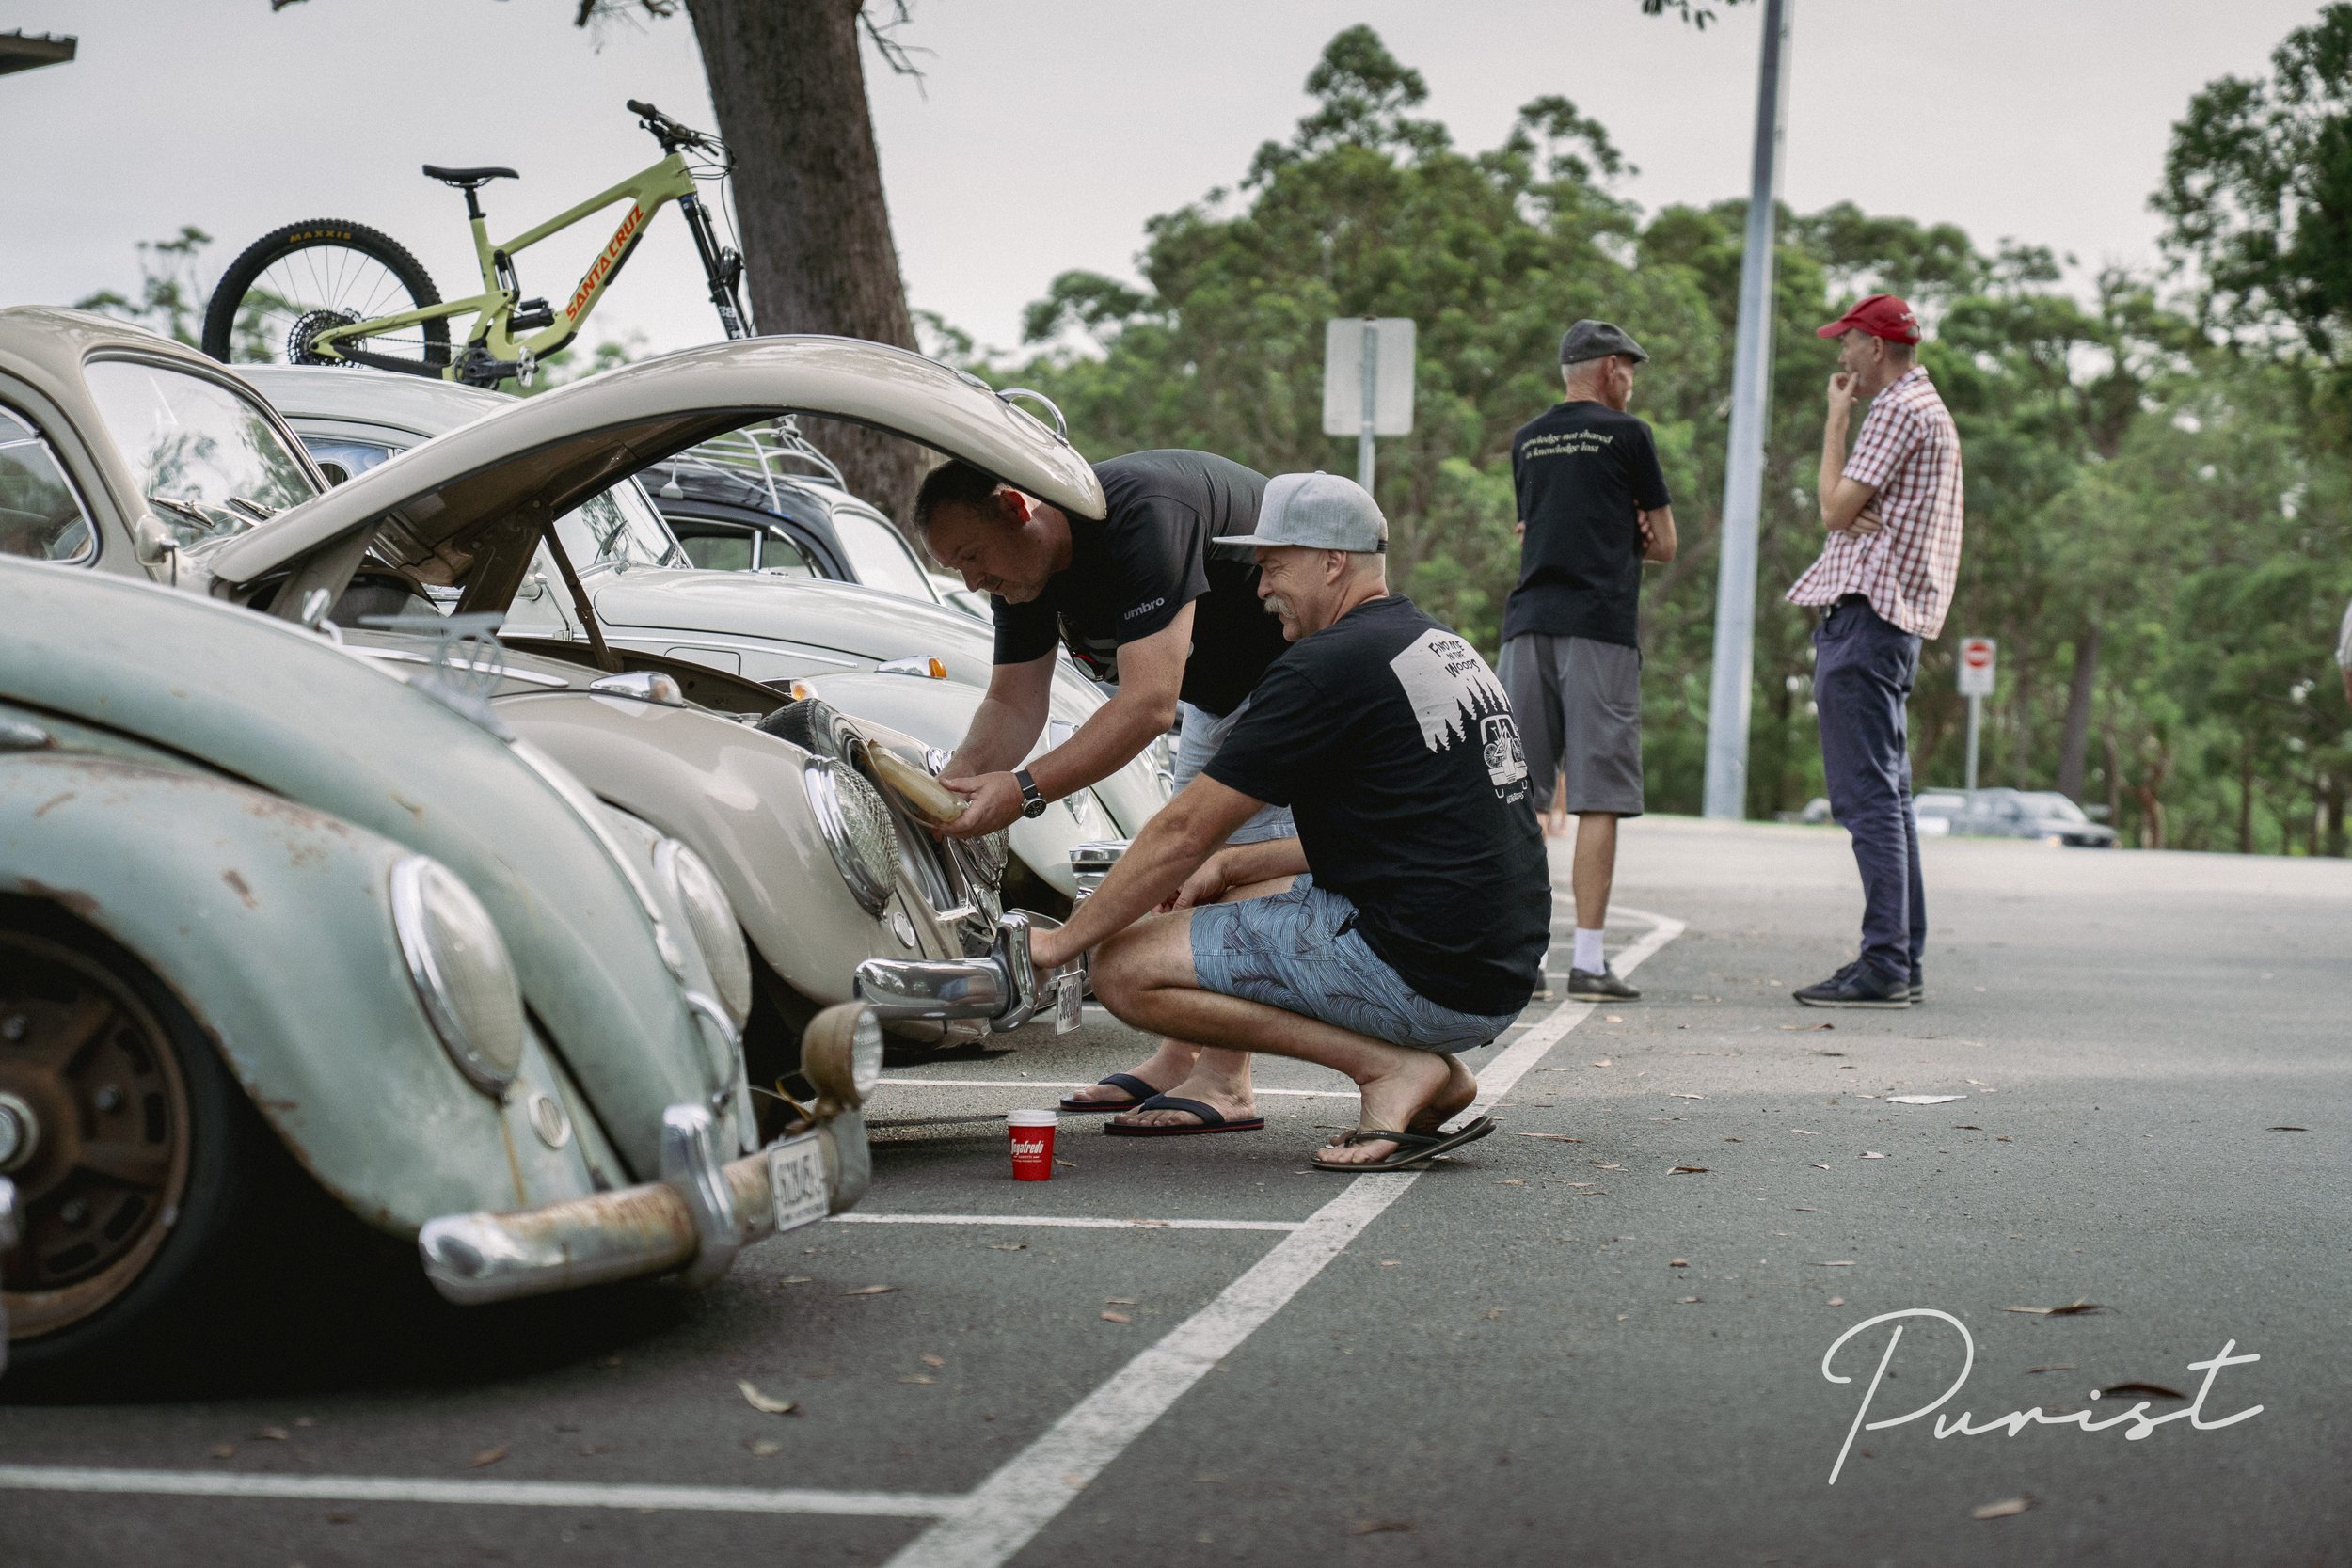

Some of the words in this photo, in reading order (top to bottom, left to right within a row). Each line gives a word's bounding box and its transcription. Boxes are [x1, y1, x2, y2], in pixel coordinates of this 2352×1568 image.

[290, 230, 352, 243] MAXXIS
[566, 255, 612, 322] SANTA
[608, 204, 644, 258] CRUZ
[1579, 429, 1613, 444] shared
[1533, 443, 1580, 456] knowledge
[1581, 441, 1599, 452] lost
[1123, 597, 1165, 621] umbro
[1428, 641, 1450, 658] FIND
[1449, 640, 1465, 652] ME
[1445, 658, 1480, 677] WOODS
